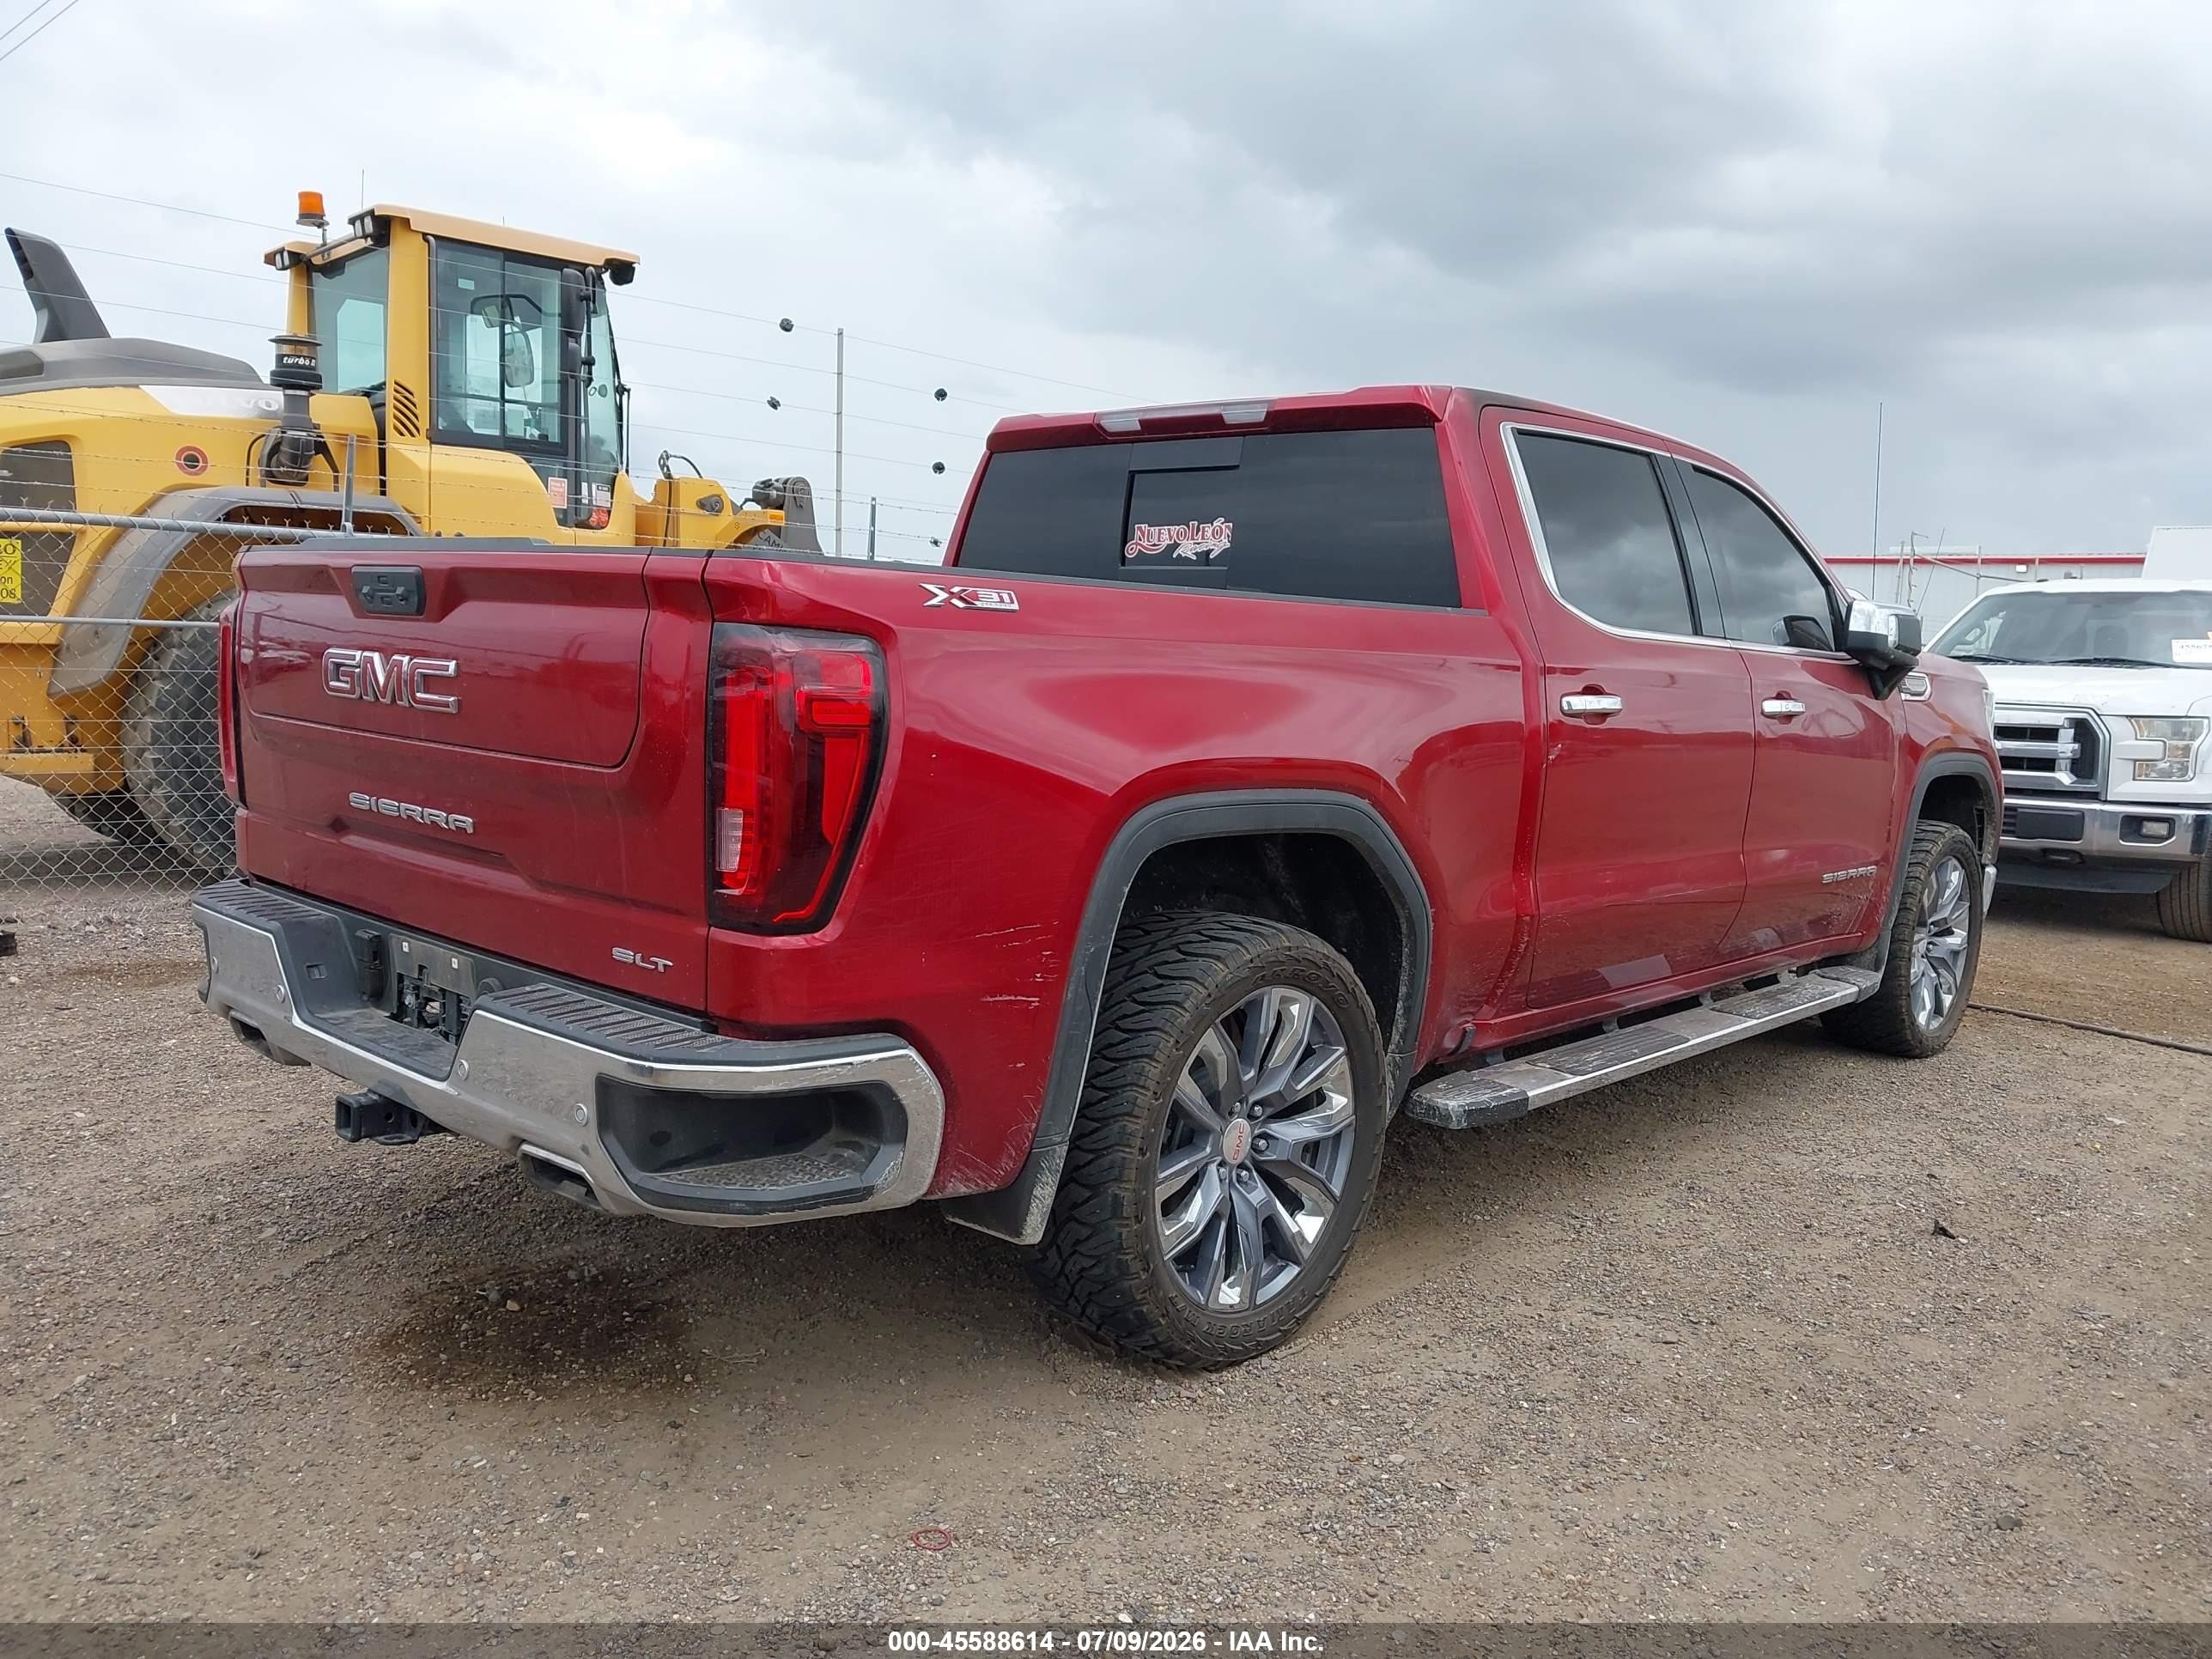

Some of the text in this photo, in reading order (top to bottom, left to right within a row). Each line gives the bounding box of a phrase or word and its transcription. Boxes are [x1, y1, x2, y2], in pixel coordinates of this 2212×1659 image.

[283, 356, 310, 366] turbo
[920, 583, 1019, 610] X31
[322, 647, 458, 714] GMC
[349, 792, 474, 834] SIERRA
[1821, 866, 1877, 884] SIERRA
[611, 947, 673, 973] SLT
[1232, 1122, 1244, 1161] GMC
